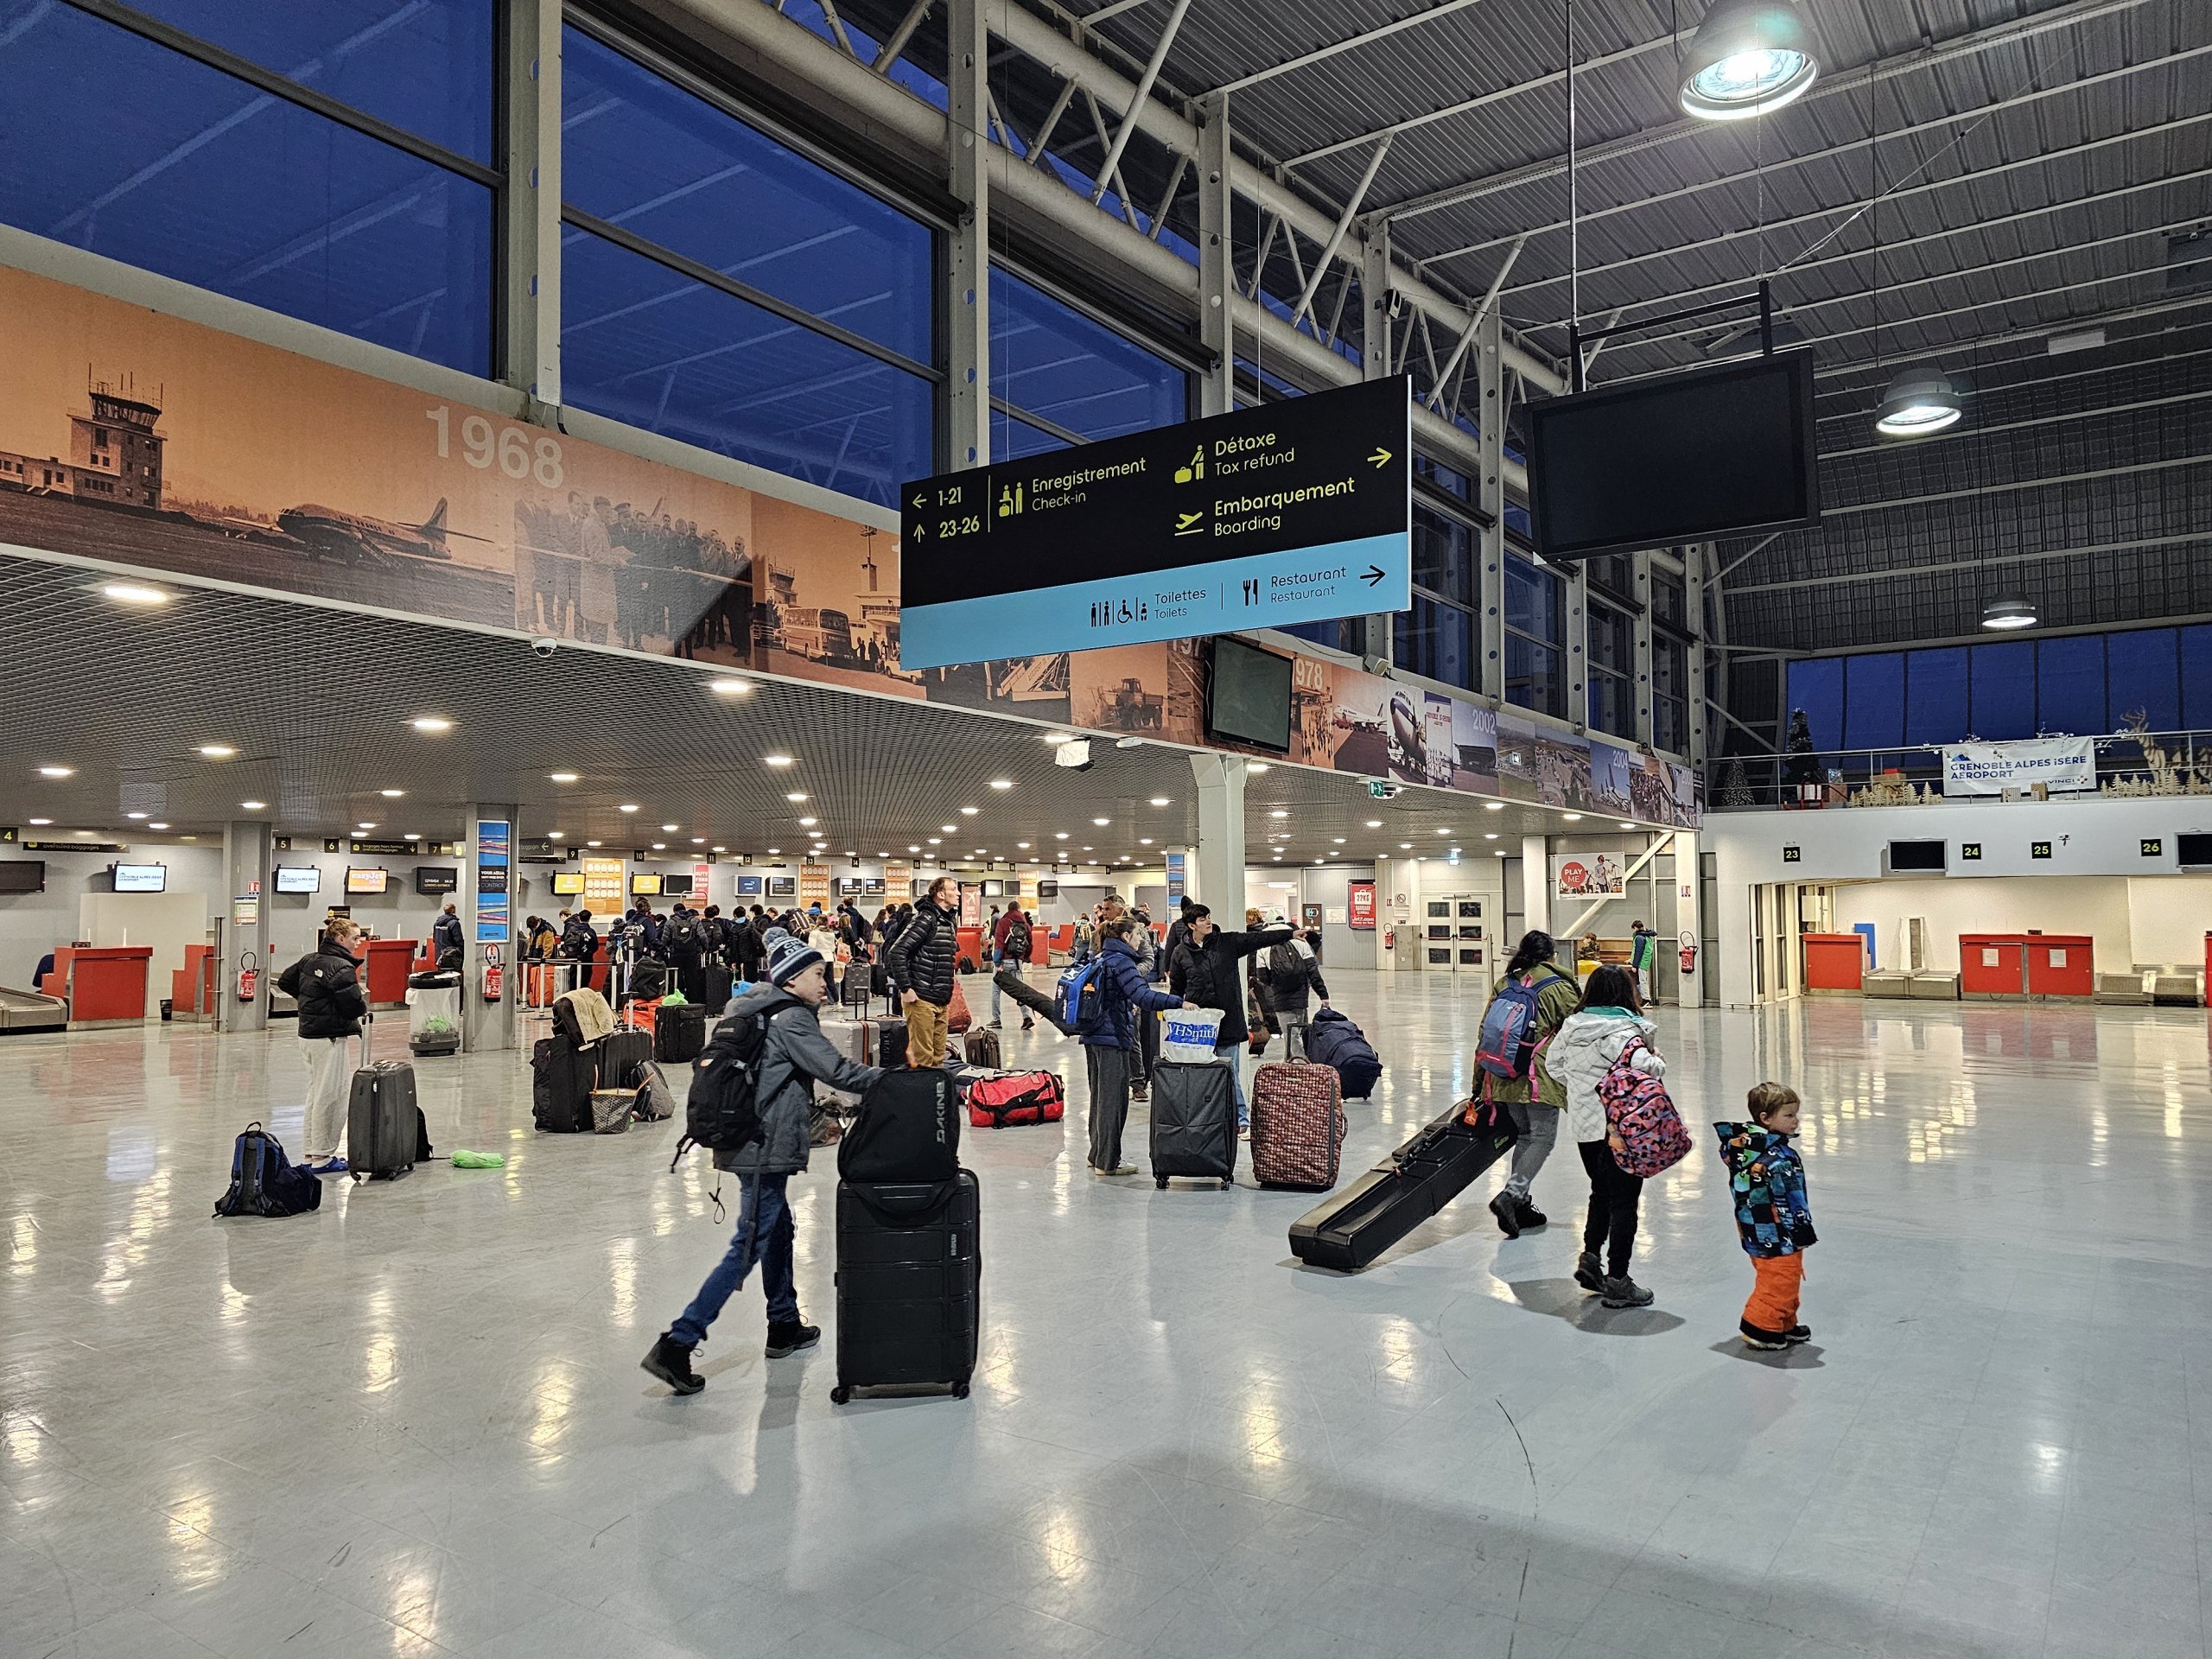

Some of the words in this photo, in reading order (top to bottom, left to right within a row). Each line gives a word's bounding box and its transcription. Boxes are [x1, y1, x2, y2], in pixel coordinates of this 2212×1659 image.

[426, 405, 563, 488] 1968
[1215, 433, 1276, 456] Détaxe
[1215, 462, 1239, 475] Tax
[1244, 448, 1294, 471] refund
[1033, 457, 1147, 493] Enregistrement
[938, 486, 962, 506] 1-21
[1032, 490, 1086, 512] Check-in
[1215, 477, 1355, 517] Embarquement
[939, 515, 980, 538] 23-26
[1215, 515, 1281, 537] Boarding
[1271, 566, 1346, 588] Restaurant
[1155, 588, 1206, 605] Toilettes
[1271, 585, 1336, 603] Restaurant
[1154, 607, 1187, 620] Toilets
[1472, 709, 1496, 734] 2002
[1612, 750, 1629, 769] 2004
[1950, 760, 2012, 772] GRENOBLE
[2014, 759, 2051, 769] ALPES
[3, 831, 12, 840] 4
[1786, 850, 1798, 858] 23
[1964, 848, 1978, 856] 24
[2034, 846, 2049, 855] 25
[2143, 843, 2160, 852] 26
